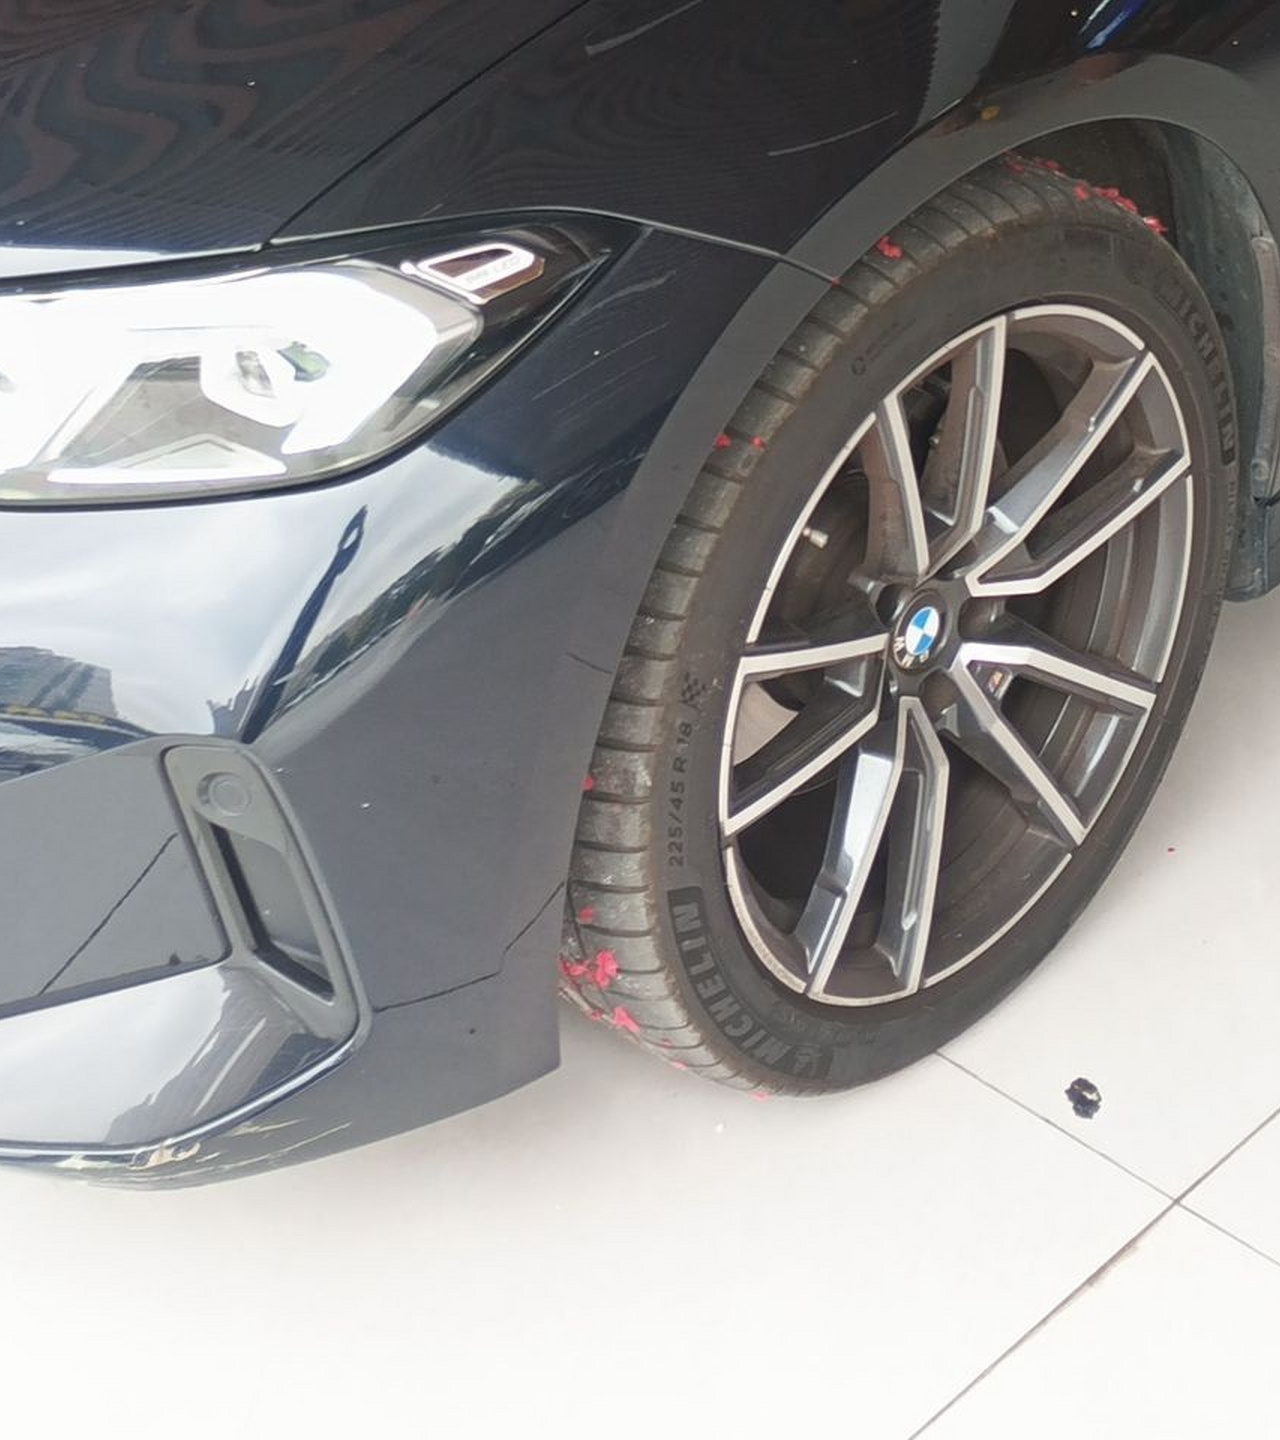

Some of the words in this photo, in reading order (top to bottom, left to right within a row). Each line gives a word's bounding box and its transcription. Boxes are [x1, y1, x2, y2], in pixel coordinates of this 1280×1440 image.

[676, 721, 693, 745] 18
[672, 757, 687, 774] R
[668, 781, 686, 868] 225/45
[671, 901, 793, 1068] MICHELIN
